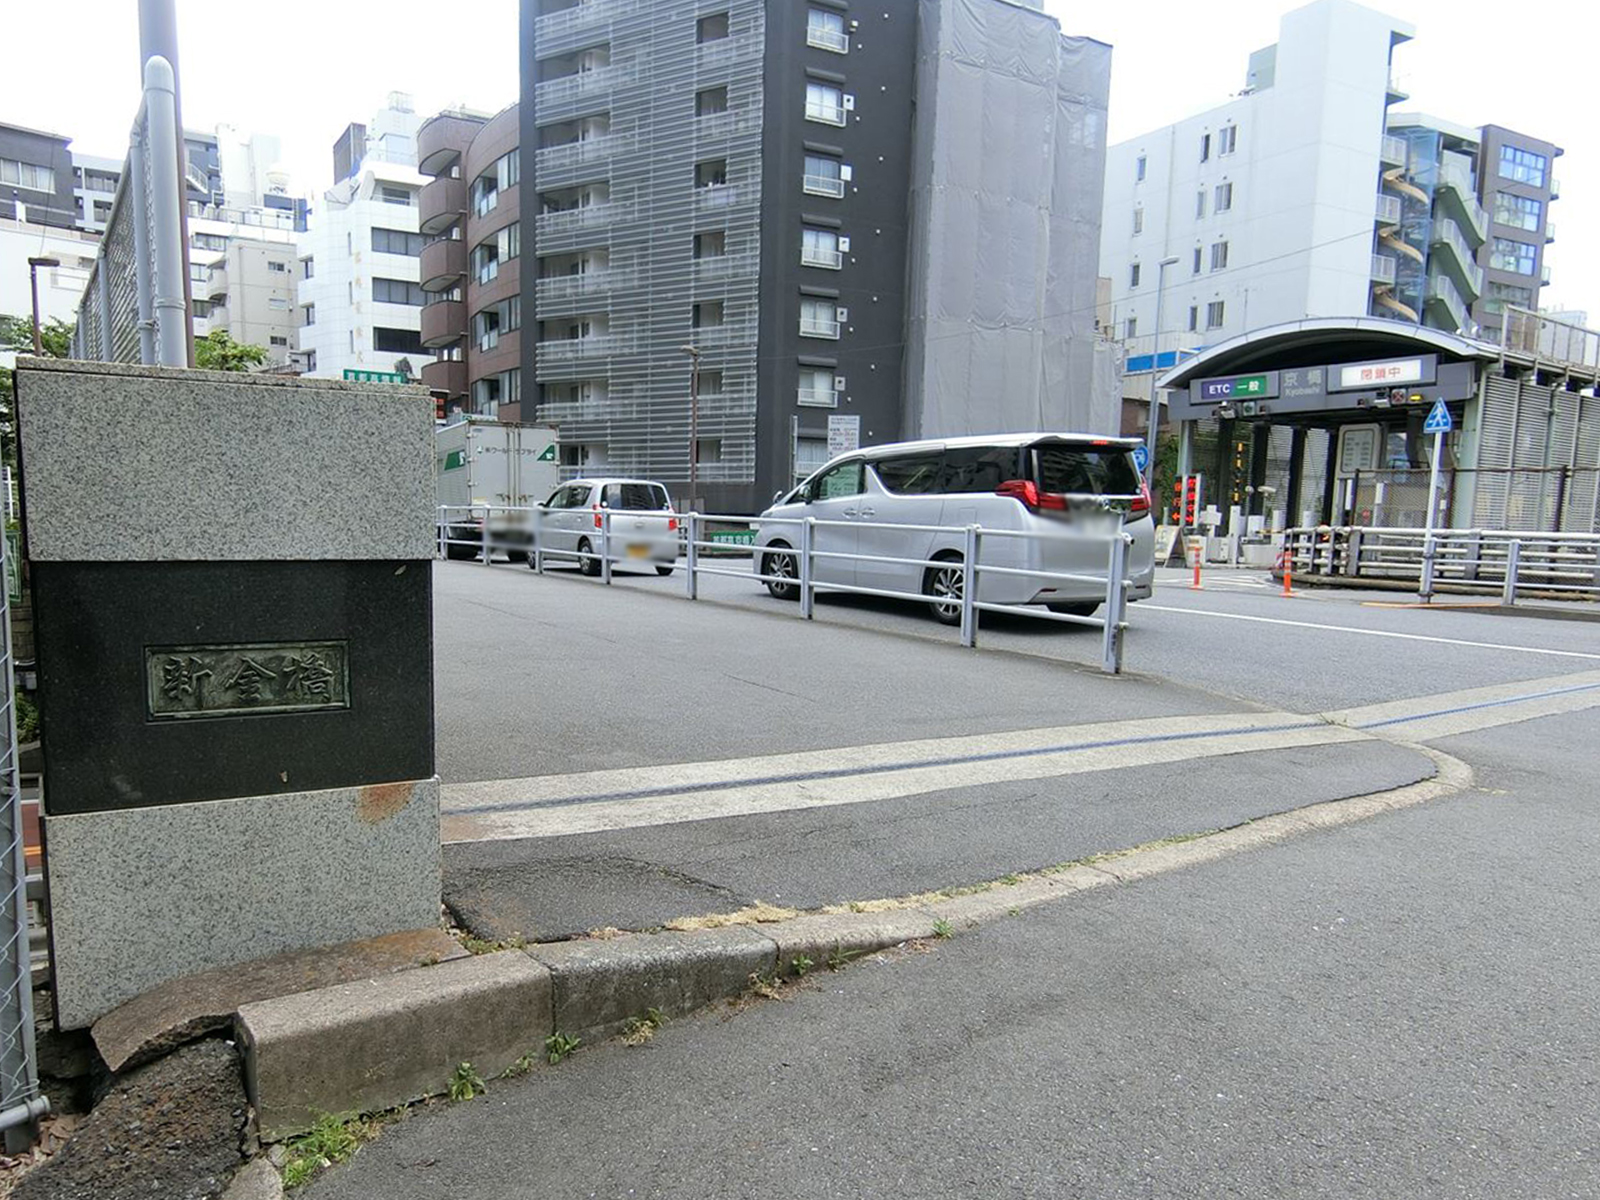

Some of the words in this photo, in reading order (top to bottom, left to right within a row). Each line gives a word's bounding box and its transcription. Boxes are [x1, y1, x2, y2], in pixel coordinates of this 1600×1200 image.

[1284, 370, 1322, 386] 京橋
[1209, 384, 1230, 394] ETC
[1237, 381, 1260, 391] 一般
[162, 653, 335, 705] 新金橋
